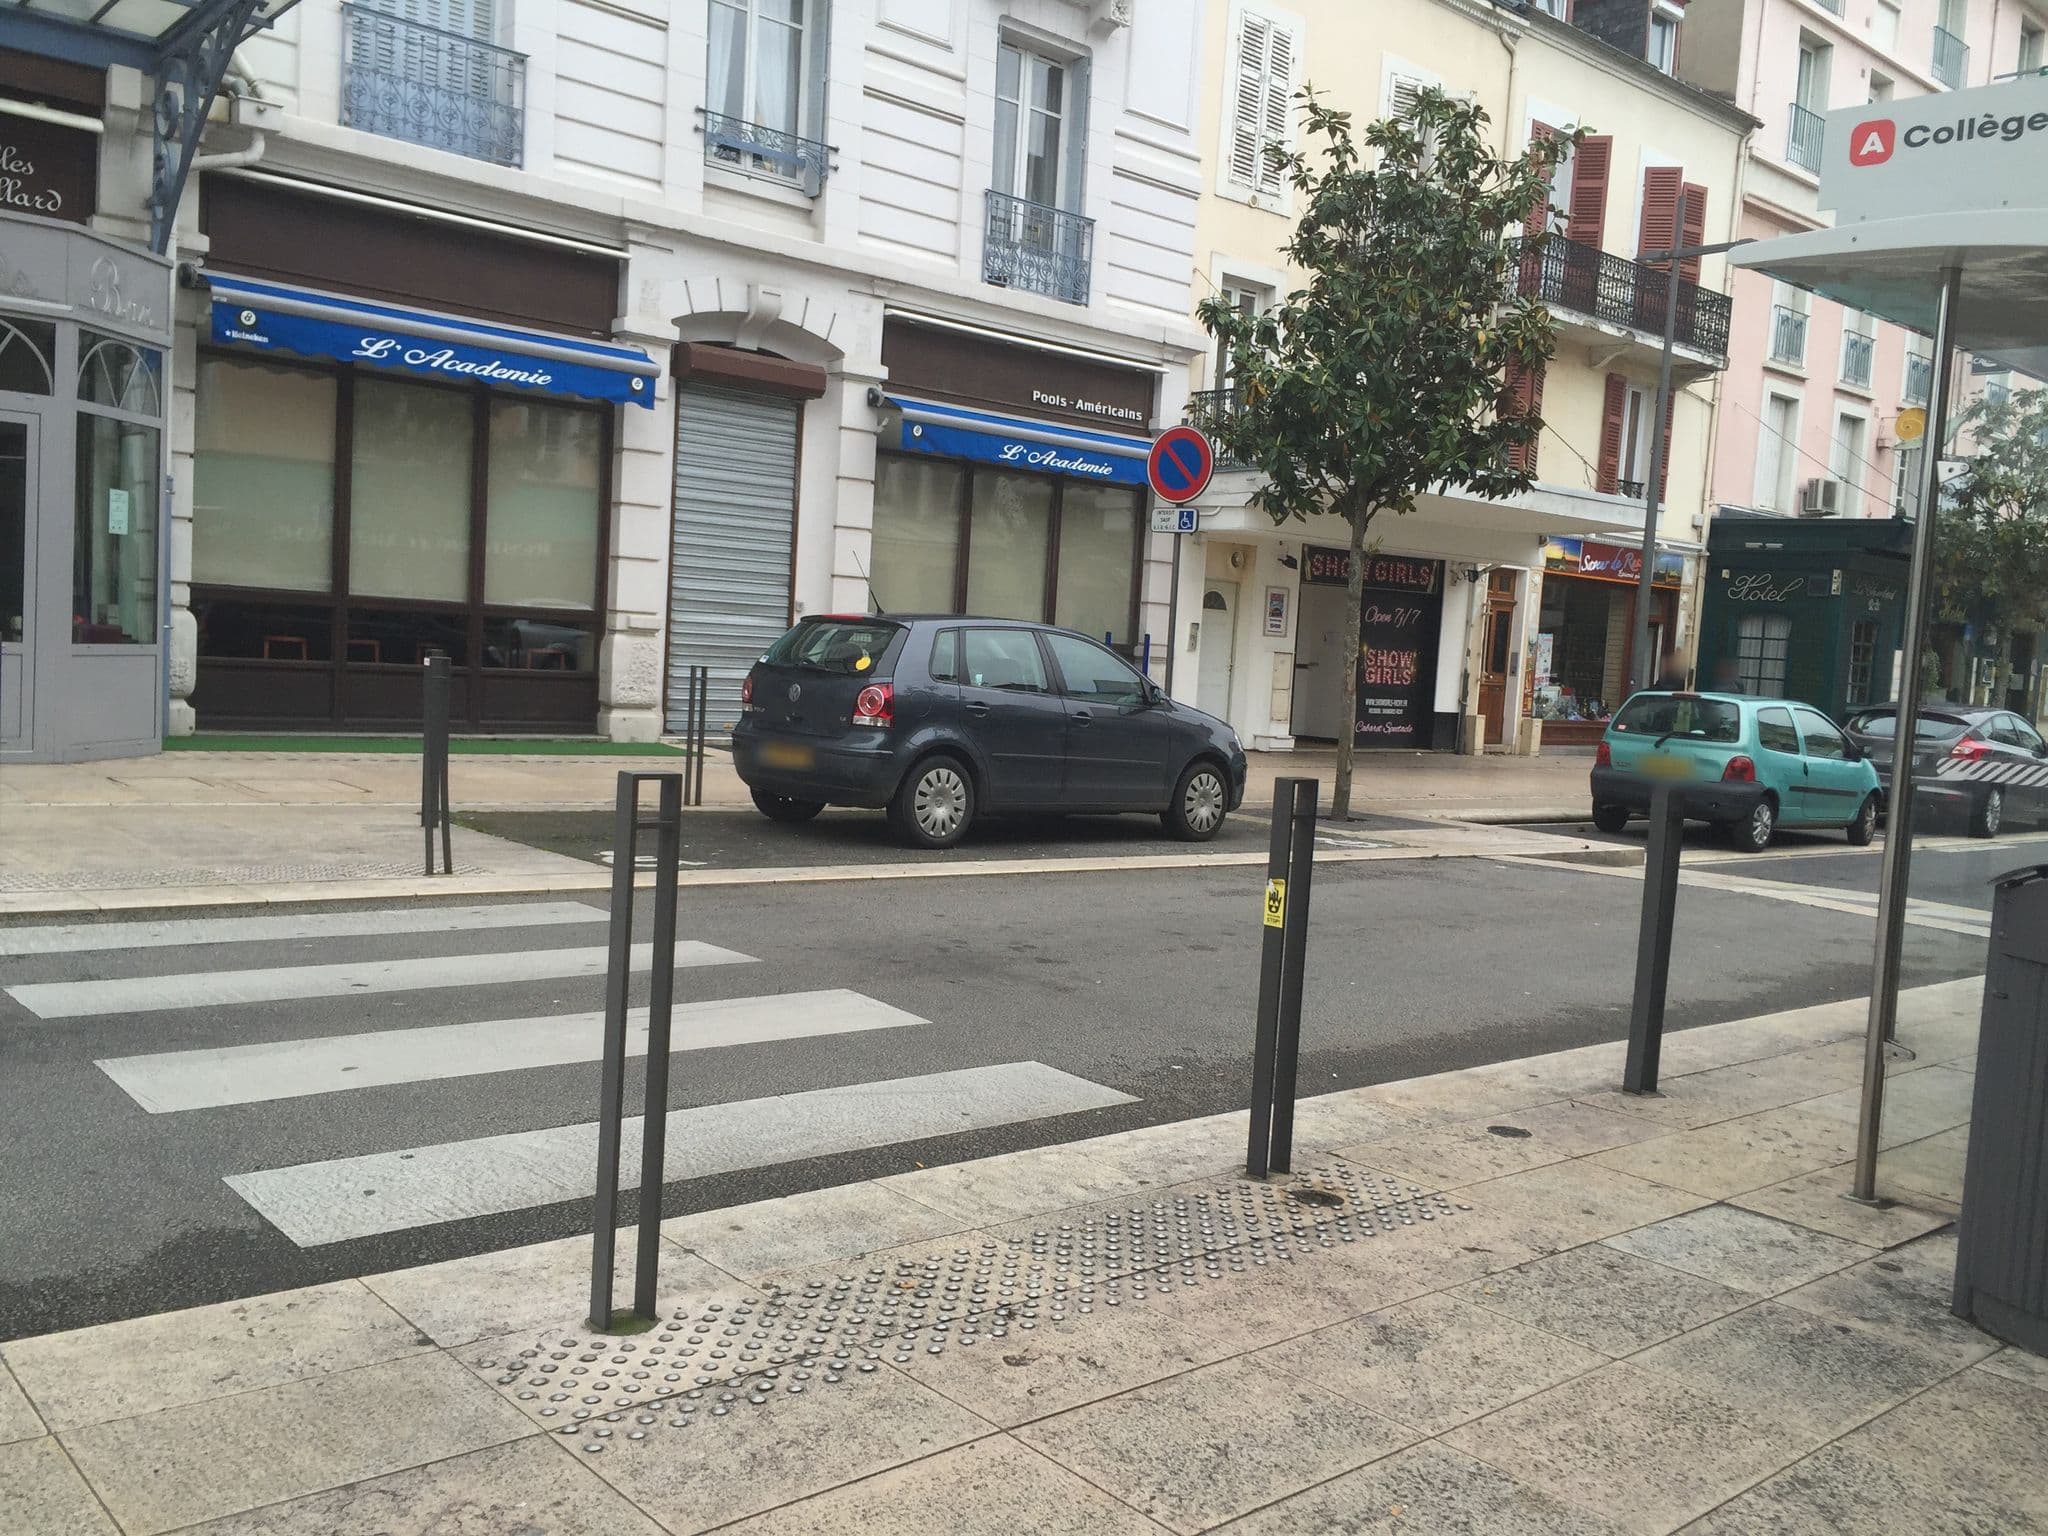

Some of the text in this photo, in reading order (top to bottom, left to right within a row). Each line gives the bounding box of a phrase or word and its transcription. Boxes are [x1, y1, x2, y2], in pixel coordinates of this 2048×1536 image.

[1859, 111, 2048, 156] A Collège
[0, 144, 35, 176] les
[1032, 390, 1067, 407] Pools
[1075, 399, 1143, 421] Américains
[1375, 561, 1431, 586] GIRLS
[1364, 604, 1393, 624] Open
[1366, 649, 1413, 668] SHOW
[1365, 667, 1412, 685] GIRLS
